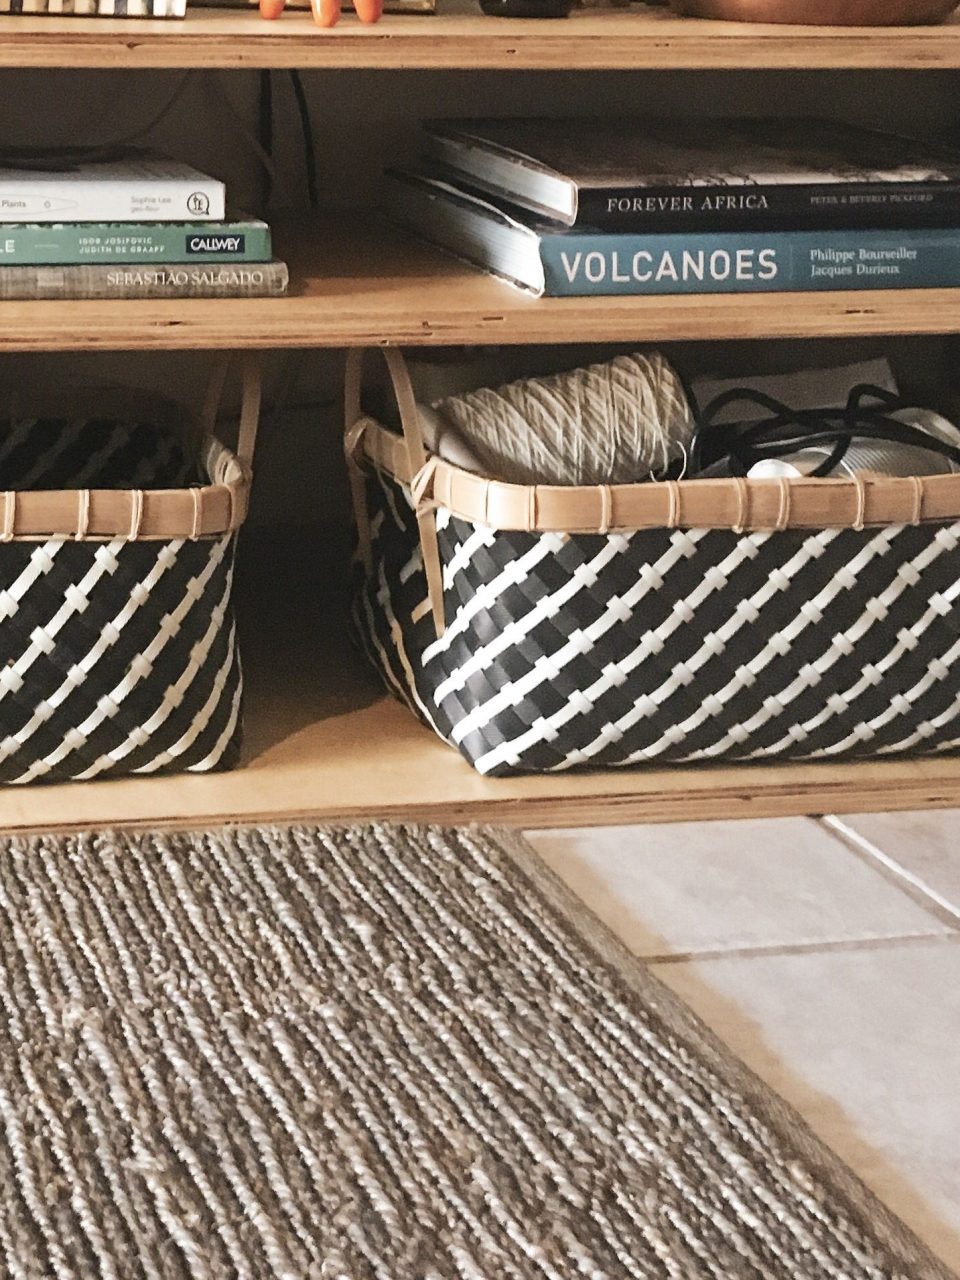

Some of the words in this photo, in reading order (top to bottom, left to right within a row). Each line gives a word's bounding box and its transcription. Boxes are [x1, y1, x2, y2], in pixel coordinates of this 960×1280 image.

[1, 200, 26, 209] Plants
[607, 197, 693, 213] FOREVER
[701, 195, 768, 209] AFRICA
[190, 237, 240, 252] CALLWEY
[810, 249, 855, 263] Philippe
[560, 249, 778, 283] VOLCANOES
[811, 265, 852, 278] Jacques
[856, 264, 900, 275] Durieux
[191, 271, 264, 285] SALGADO
